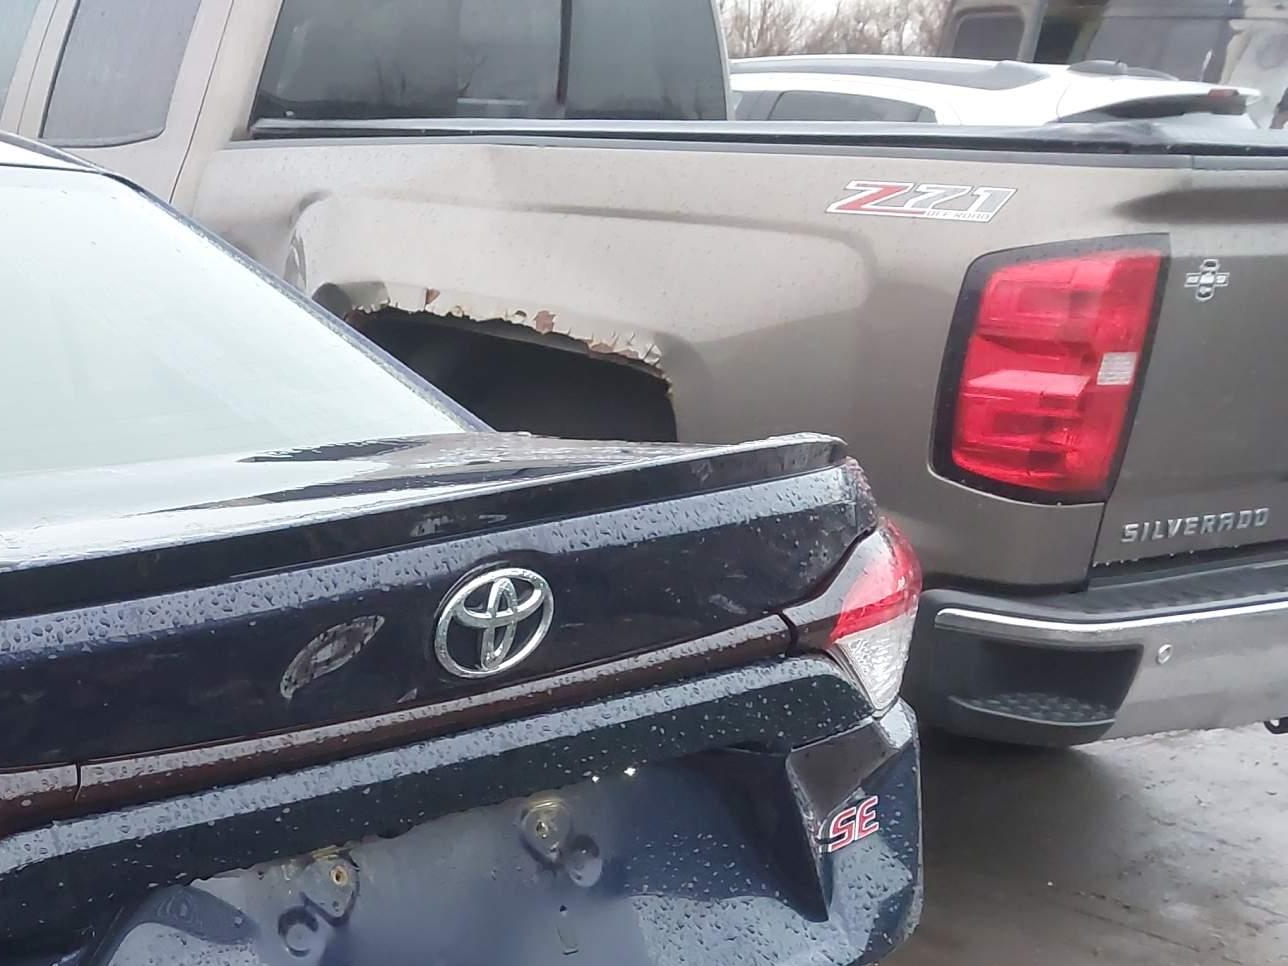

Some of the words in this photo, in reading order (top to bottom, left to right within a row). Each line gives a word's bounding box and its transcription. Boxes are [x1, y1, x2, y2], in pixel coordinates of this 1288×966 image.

[825, 180, 1018, 217] Z71
[1121, 507, 1270, 543] SILVERADO
[827, 794, 880, 853] SE
